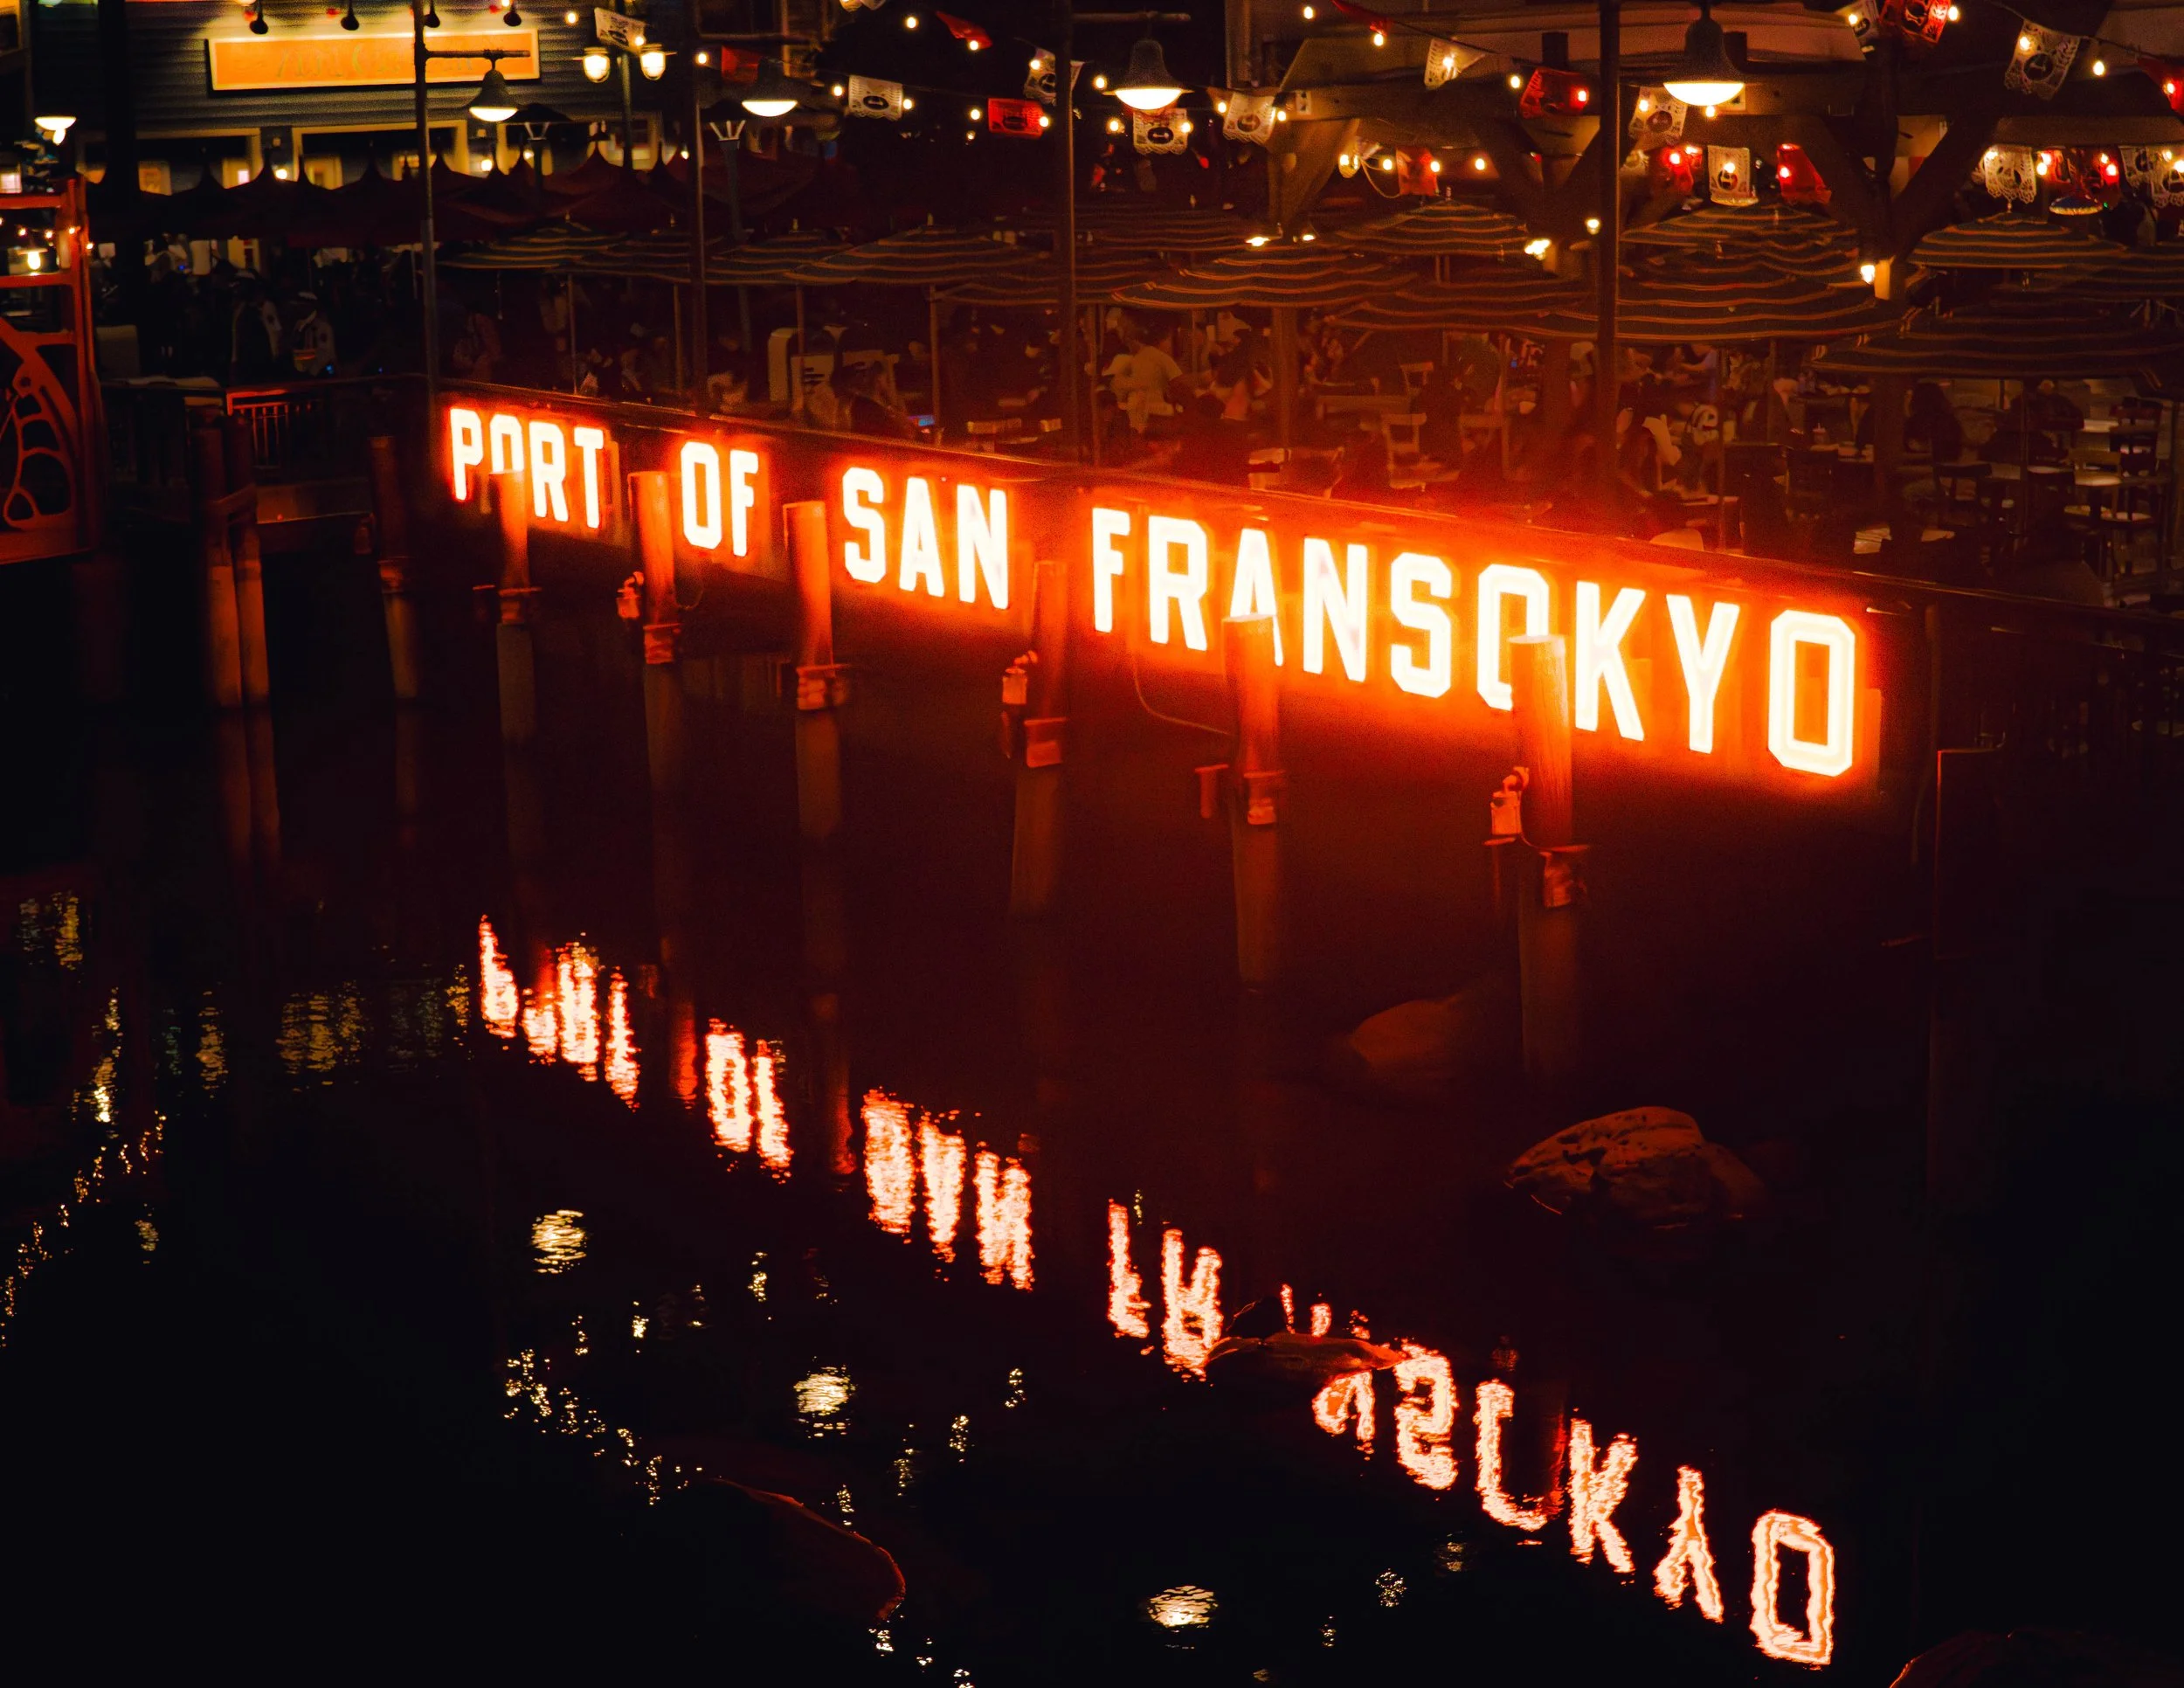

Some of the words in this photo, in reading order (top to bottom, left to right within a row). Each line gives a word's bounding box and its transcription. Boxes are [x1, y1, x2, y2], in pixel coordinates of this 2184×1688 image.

[449, 407, 605, 529] PORT
[680, 439, 760, 557] OF
[841, 466, 1010, 611] SAN
[1091, 506, 1857, 778] FRANSOKYO
